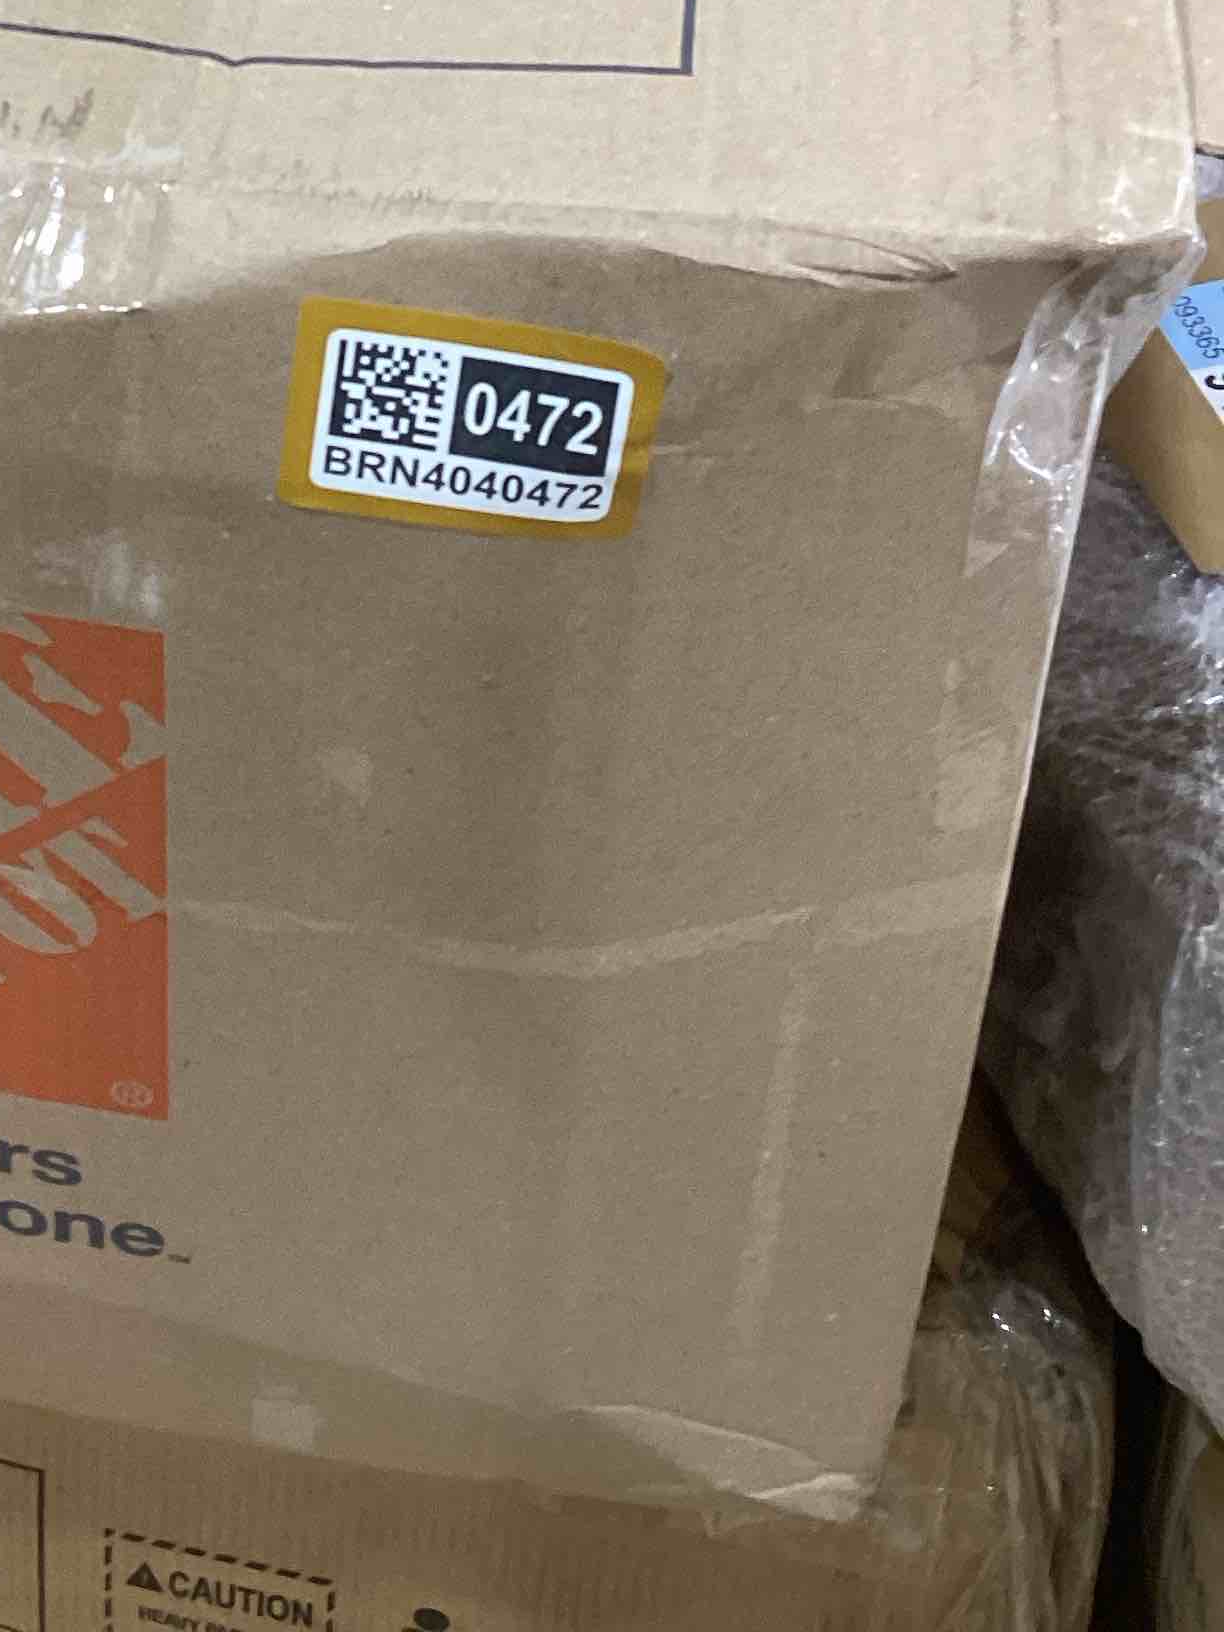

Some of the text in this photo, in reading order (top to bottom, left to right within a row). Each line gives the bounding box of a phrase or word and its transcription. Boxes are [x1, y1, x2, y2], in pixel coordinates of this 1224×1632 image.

[463, 382, 605, 456] 0472
[323, 444, 604, 511] BRN4040472
[168, 1570, 313, 1628] CAUTION
